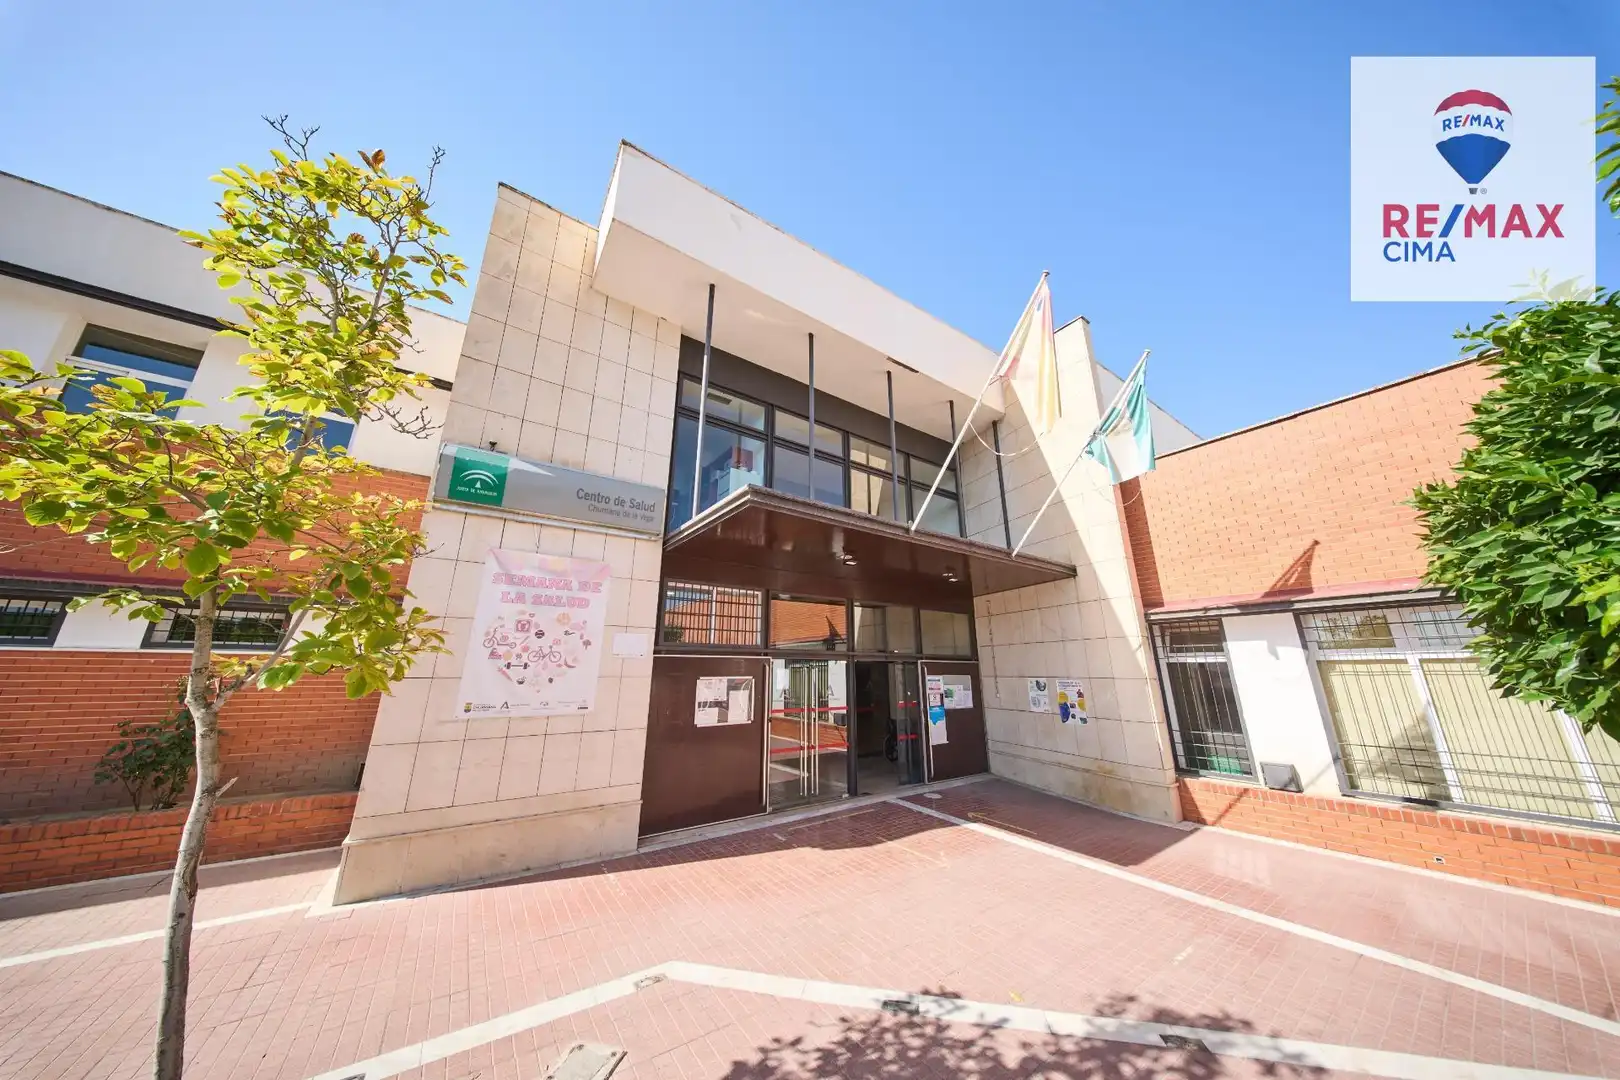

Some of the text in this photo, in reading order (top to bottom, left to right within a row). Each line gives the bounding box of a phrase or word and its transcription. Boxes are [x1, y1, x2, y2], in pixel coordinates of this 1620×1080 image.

[576, 488, 656, 513] Centro de Salud
[492, 572, 603, 594] SEMANA DE
[501, 591, 590, 609] LA SALUD
